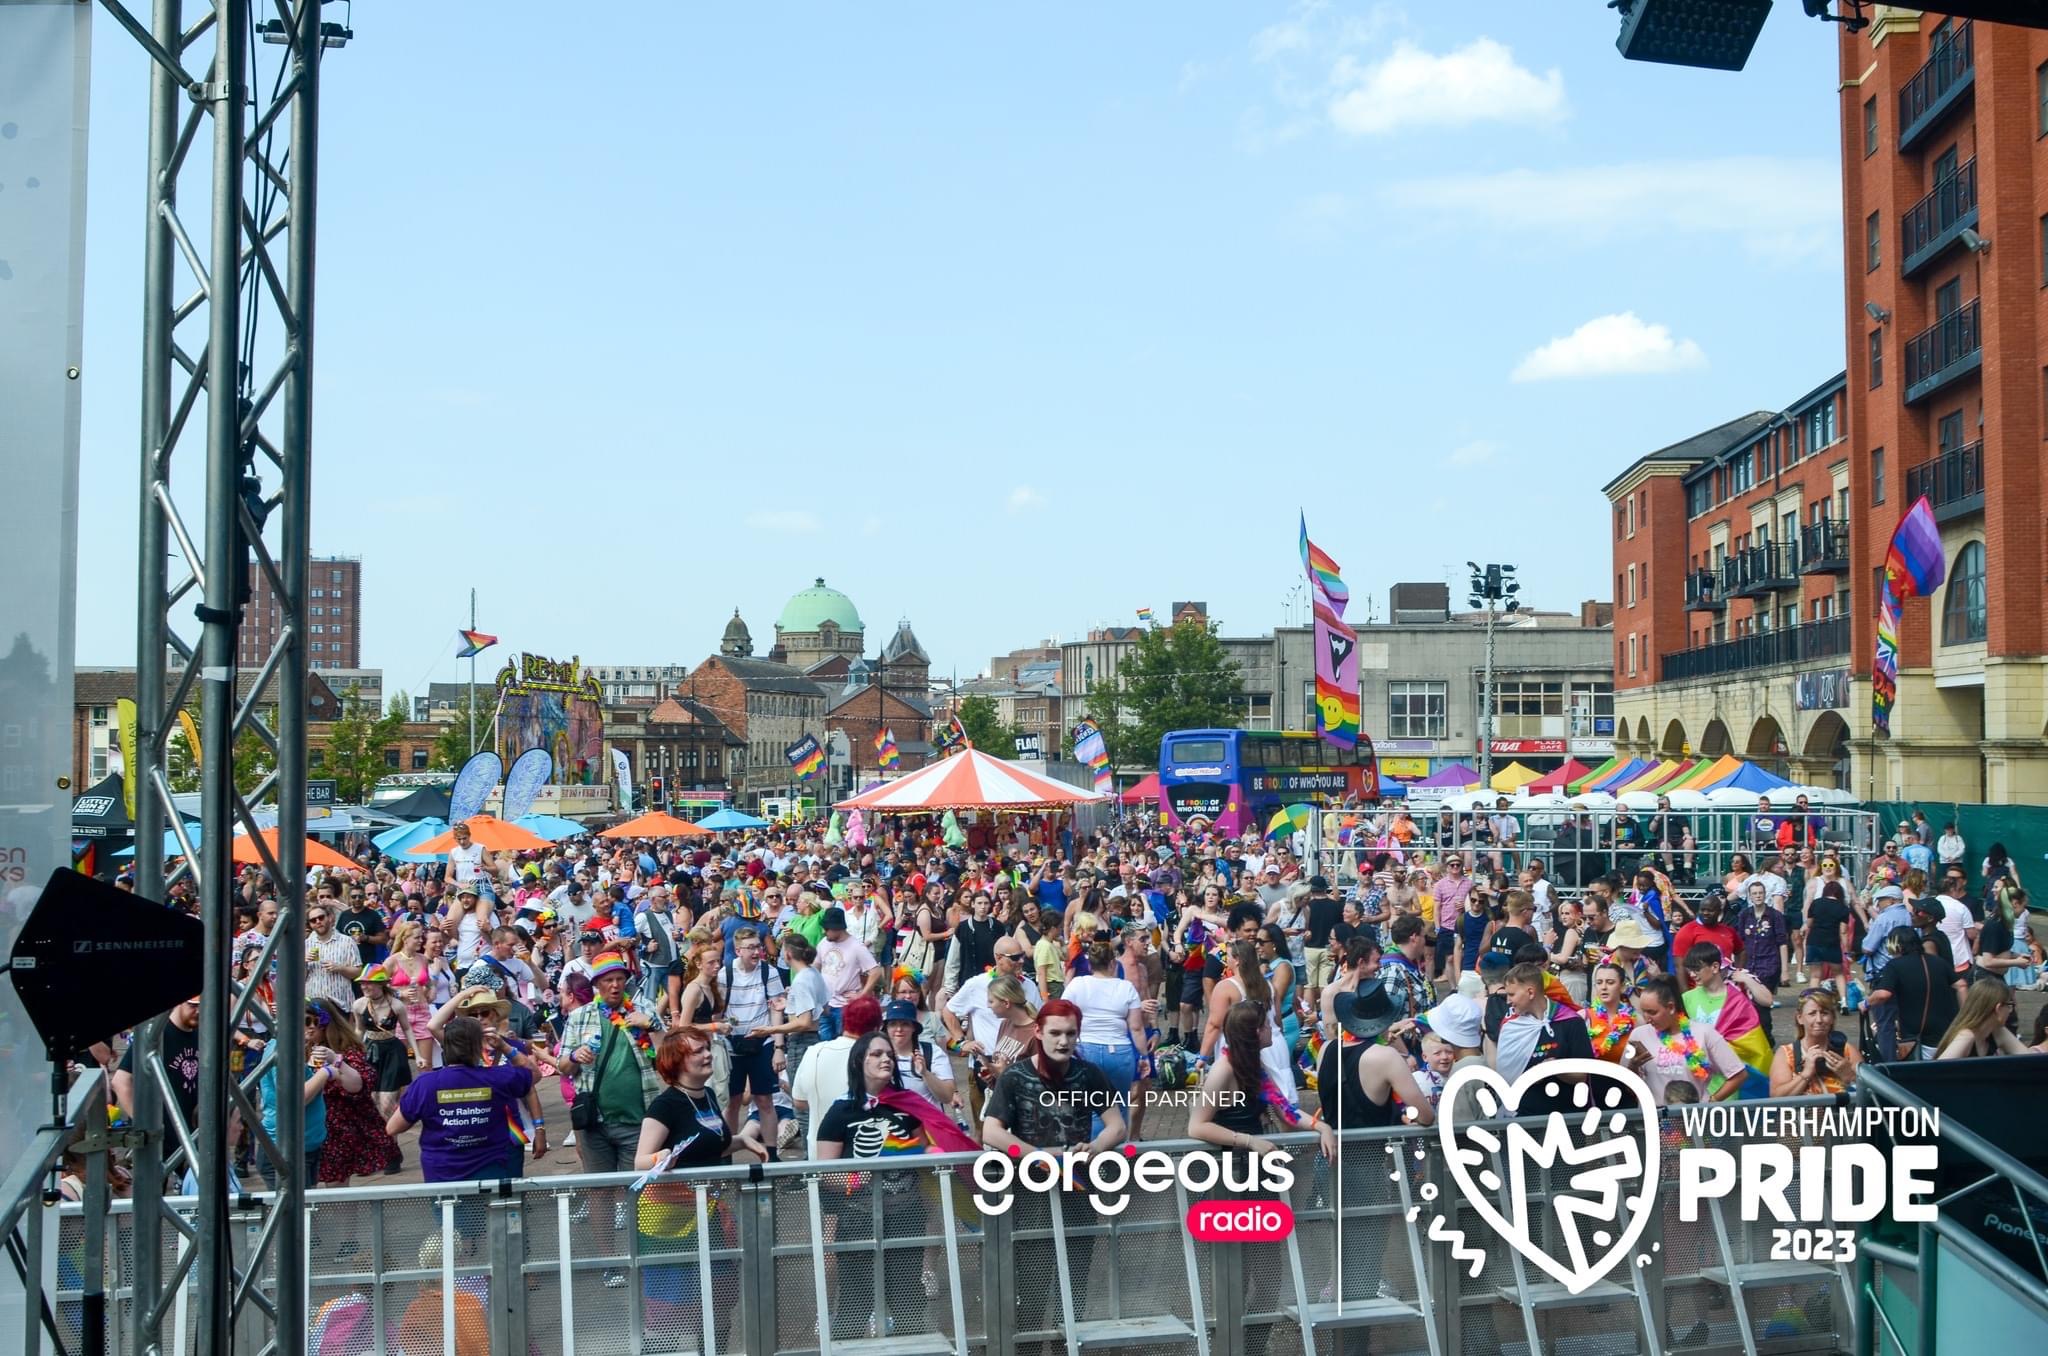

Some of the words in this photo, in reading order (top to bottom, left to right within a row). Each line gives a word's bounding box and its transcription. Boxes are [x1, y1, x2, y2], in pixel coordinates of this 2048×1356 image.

[1015, 736, 1039, 750] FLAG
[1253, 778, 1263, 790] BE
[1289, 777, 1299, 789] OF
[1300, 776, 1317, 788] WHO
[1317, 776, 1332, 788] YOU
[1333, 775, 1345, 788] ARE
[306, 787, 315, 800] HE
[316, 787, 330, 800] BAR
[96, 939, 184, 951] SENNHEISER
[439, 1108, 455, 1116] Our
[456, 1106, 492, 1116] Rainbow
[442, 1117, 469, 1126] Action
[471, 1116, 489, 1125] Plan
